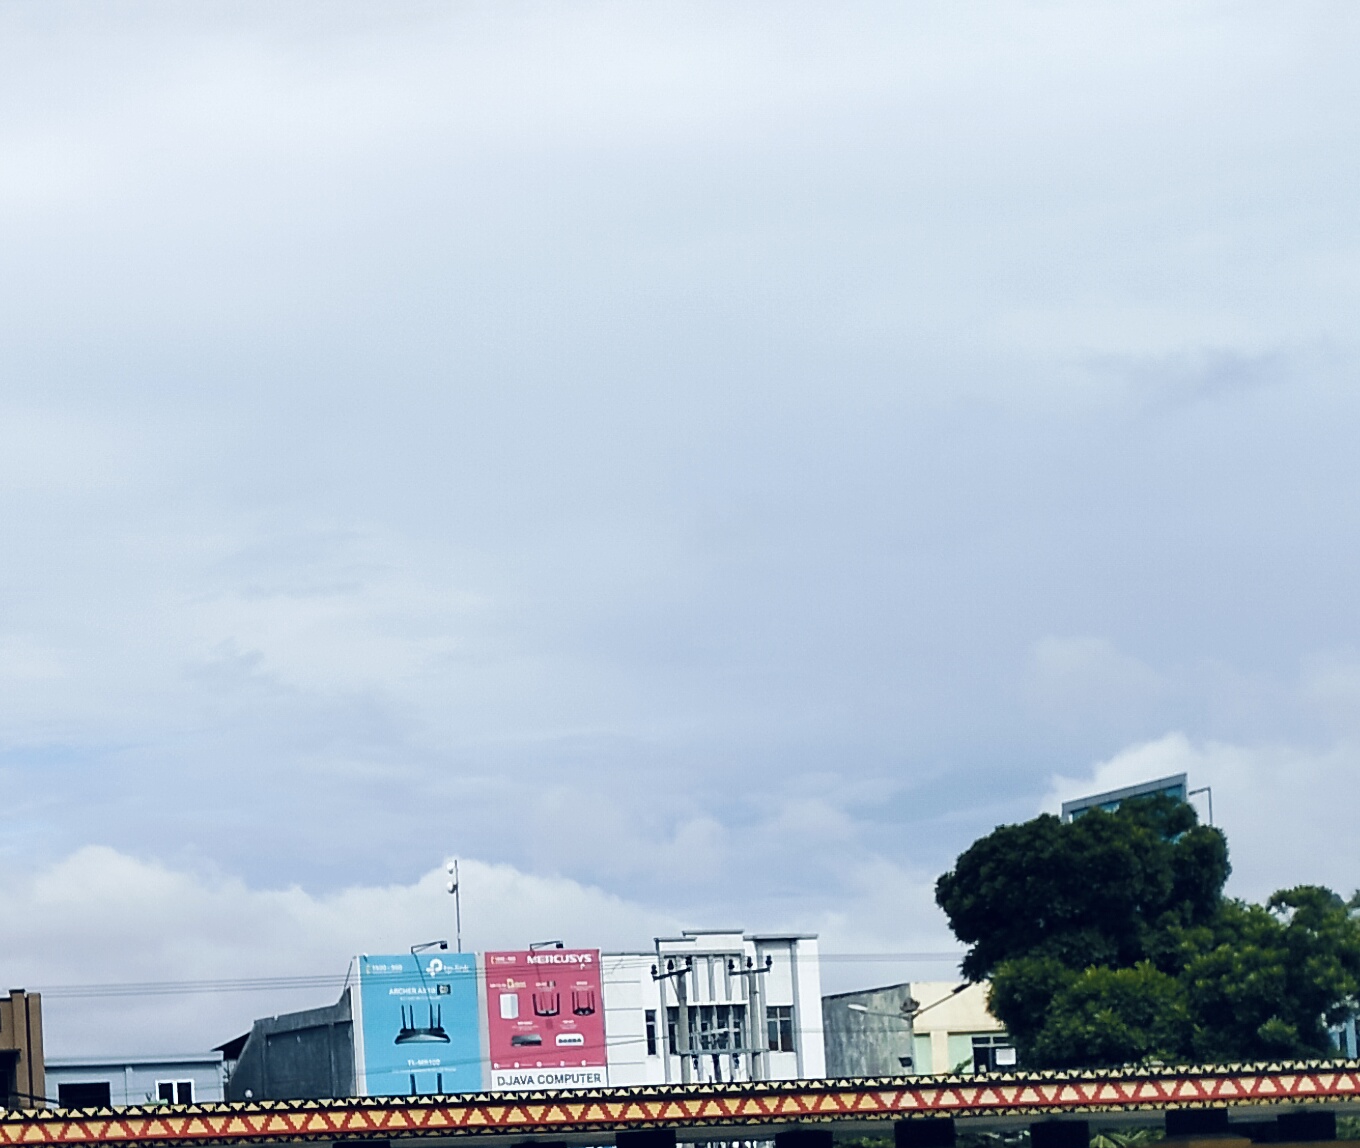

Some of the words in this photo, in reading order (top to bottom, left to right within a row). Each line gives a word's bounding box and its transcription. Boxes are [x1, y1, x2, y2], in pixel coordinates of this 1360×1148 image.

[526, 953, 592, 965] MERCUSYS
[497, 1074, 535, 1087] DJAVA
[537, 1072, 602, 1085] COMPUTER
